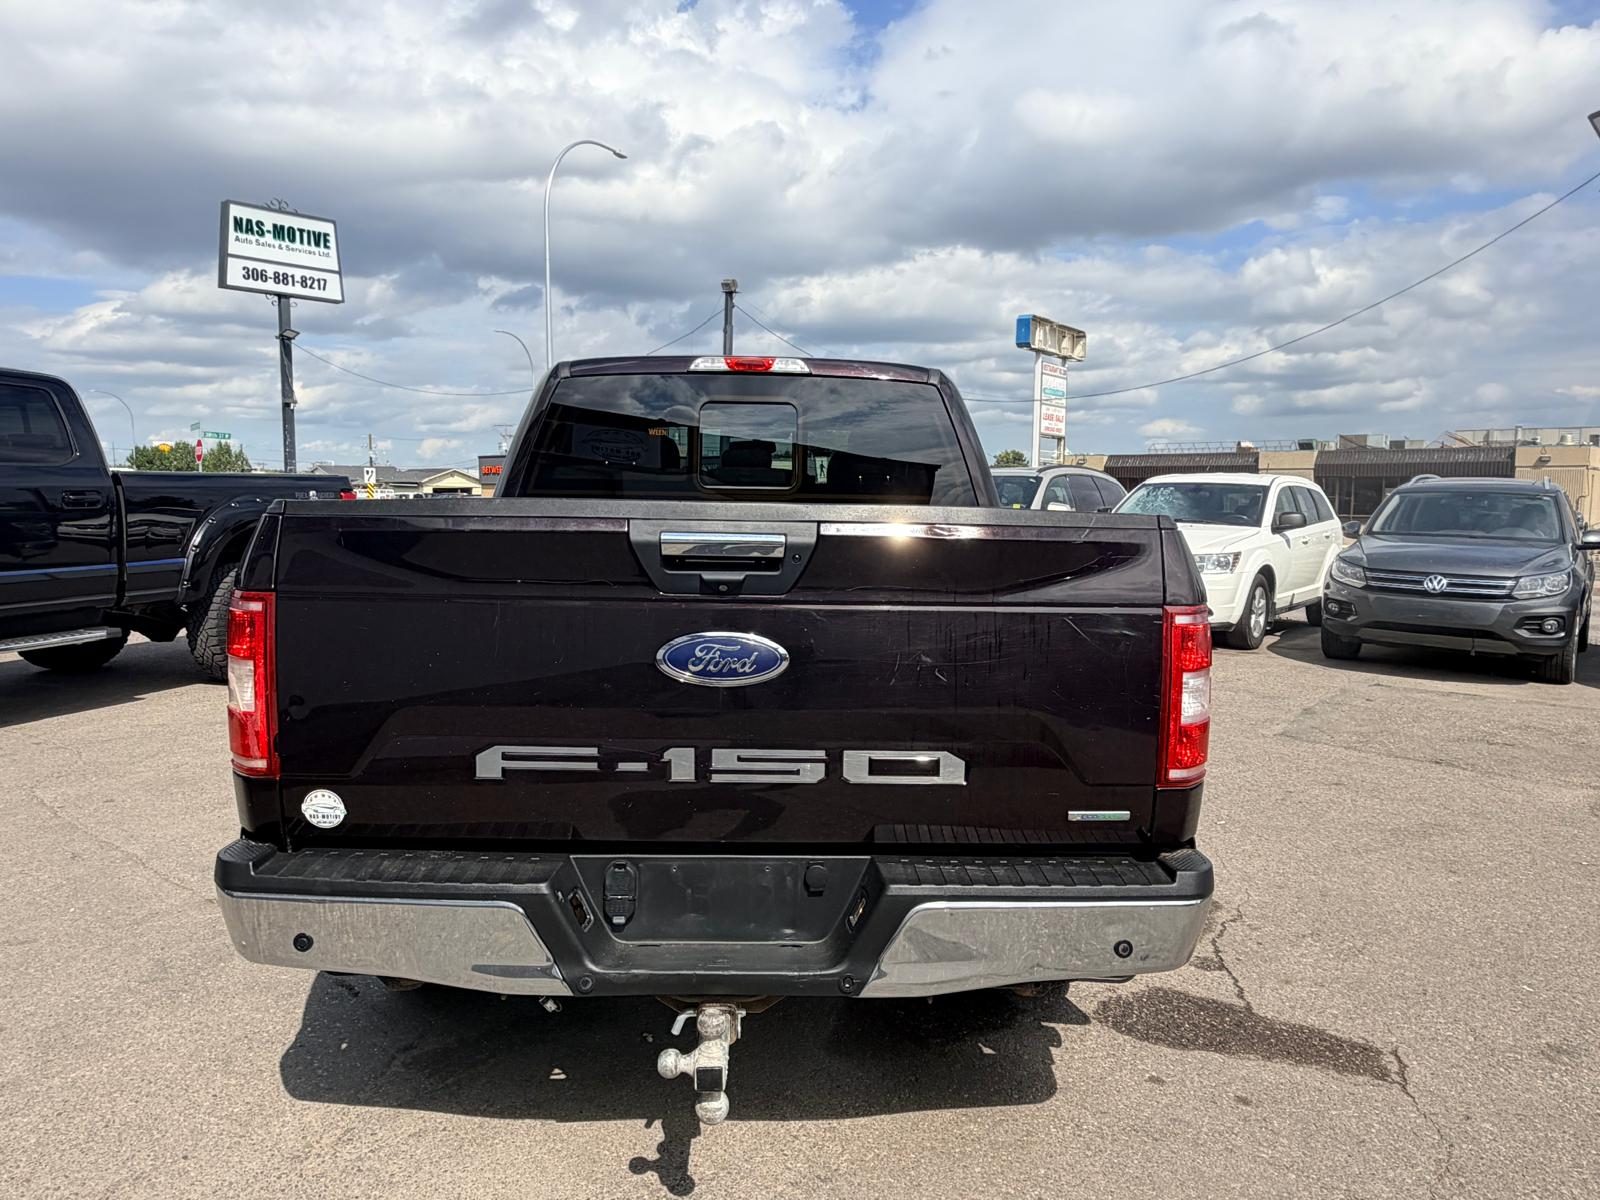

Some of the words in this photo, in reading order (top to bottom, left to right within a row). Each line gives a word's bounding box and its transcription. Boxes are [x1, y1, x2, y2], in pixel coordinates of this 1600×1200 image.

[233, 215, 331, 249] NAS-MOTIVE
[234, 235, 253, 245] Auto
[255, 239, 276, 249] Sales
[285, 244, 316, 255] Services
[242, 266, 327, 291] 306-881-8217
[687, 643, 757, 675] Ford
[475, 745, 966, 785] F-150
